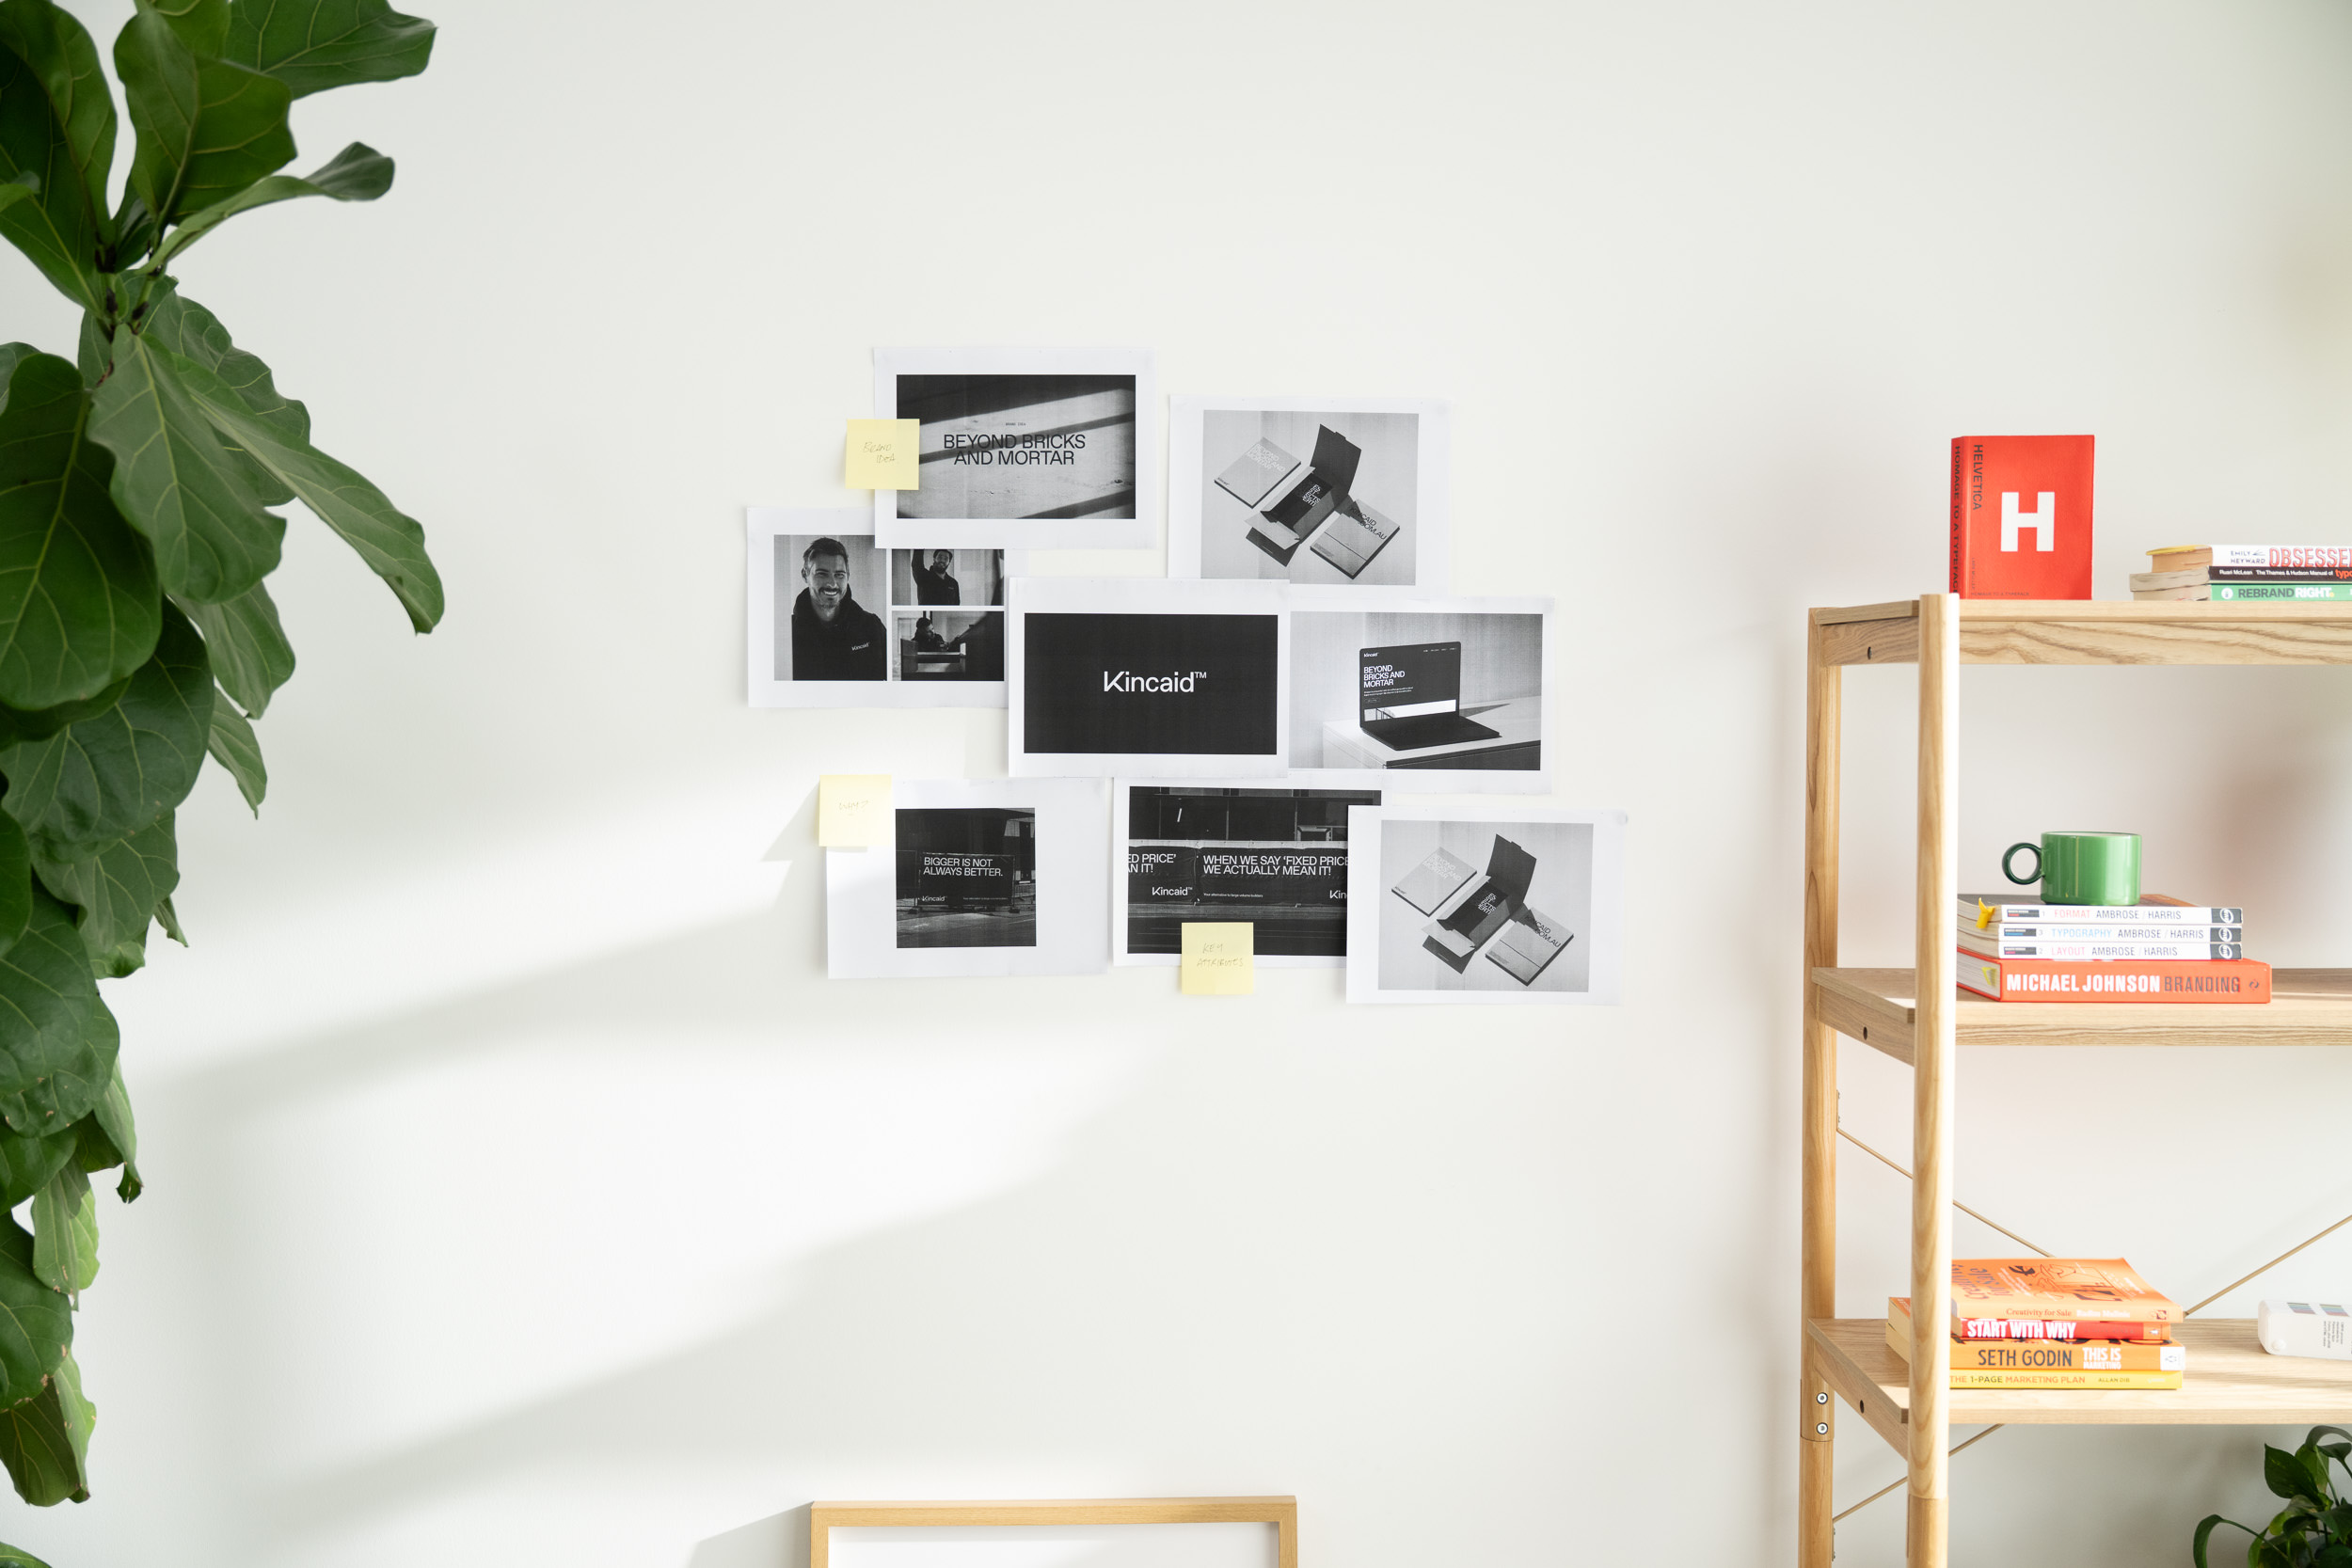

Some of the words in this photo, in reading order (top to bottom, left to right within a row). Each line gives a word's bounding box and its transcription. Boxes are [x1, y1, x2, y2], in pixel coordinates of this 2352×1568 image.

[944, 435, 1017, 449] BEYOND
[1023, 435, 1086, 449] BRICKS
[954, 451, 993, 466] AND
[998, 451, 1074, 466] MORTAR
[1973, 445, 1983, 510] HELVETICA
[1953, 504, 1960, 519] TO
[2001, 492, 2055, 552] H
[1364, 665, 1392, 674] BEYOND
[1364, 672, 1389, 681] BRICKS
[1364, 678, 1393, 688] MORTAR
[924, 857, 960, 866] BIGGER
[962, 859, 971, 867] IS
[973, 859, 993, 867] NOT
[1203, 855, 1237, 865] WHEN
[1240, 855, 1258, 865] WE
[1260, 856, 1281, 865] SAY
[923, 867, 962, 876] ALWAYS
[963, 868, 1003, 877] BETTER.
[1141, 863, 1153, 873] IT!
[1203, 864, 1221, 875] WE
[1223, 865, 1280, 875] ACTUALLY
[1282, 866, 1315, 876] MEAN
[1319, 866, 1331, 876] IT!
[1329, 890, 1347, 899] Kin
[2055, 910, 2090, 918] FORMAT
[2096, 910, 2139, 919] AMBROSE
[2148, 911, 2182, 920] HARRIS
[2052, 928, 2112, 938] TYPOGRAPHY
[2118, 929, 2162, 939] AMBROSE
[2170, 929, 2204, 939] HARRIS
[2052, 947, 2086, 956] LAYOUT
[2091, 947, 2136, 957] AMBROSE
[2144, 947, 2178, 957] HARRIS
[2007, 974, 2080, 992] MICHAEL
[2082, 974, 2160, 993] JOHNSON
[2164, 976, 2241, 993] BRANDING
[2006, 1308, 2042, 1318] Creativity
[2044, 1308, 2055, 1317] for
[1967, 1321, 2008, 1338] START
[2009, 1322, 2044, 1338] WITH
[2045, 1323, 2076, 1338] WHY
[1979, 1350, 2017, 1366] SETH
[2023, 1351, 2073, 1367] GODIN
[2082, 1347, 2107, 1361] THIS
[2110, 1348, 2122, 1361] IS
[2083, 1361, 2122, 1370] MARKETING
[2006, 1375, 2058, 1384] MARKETING
